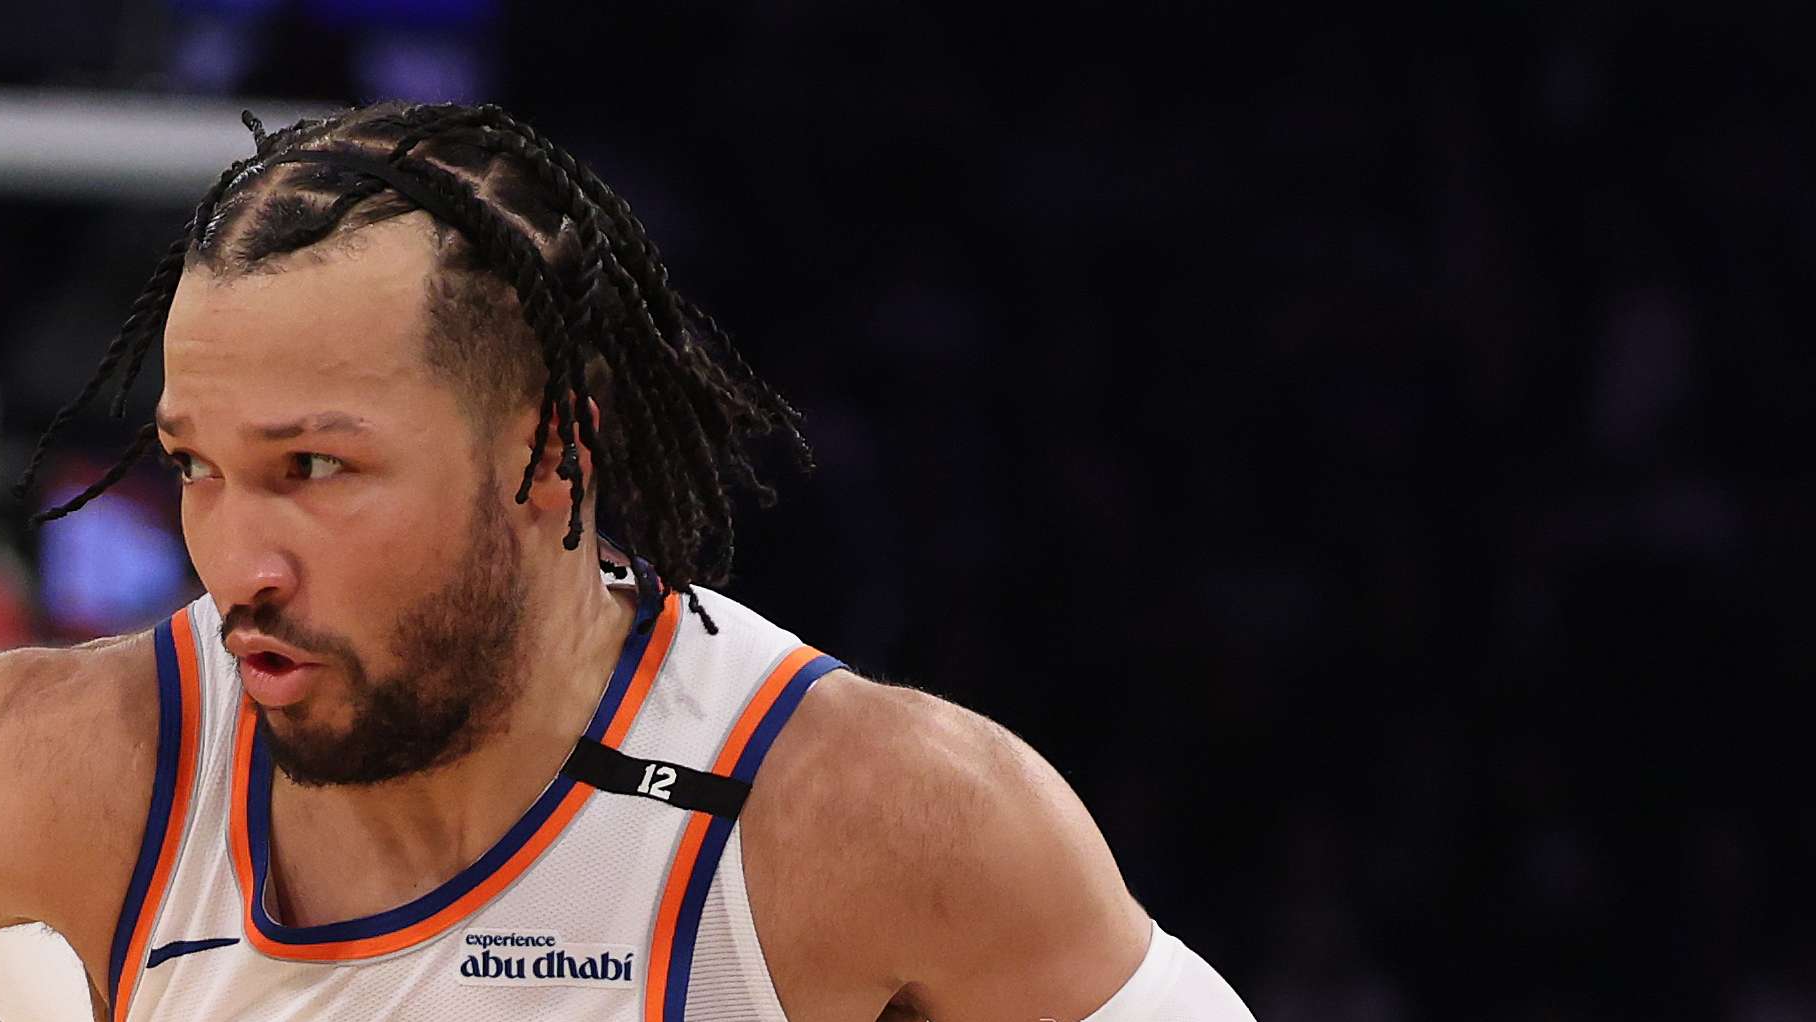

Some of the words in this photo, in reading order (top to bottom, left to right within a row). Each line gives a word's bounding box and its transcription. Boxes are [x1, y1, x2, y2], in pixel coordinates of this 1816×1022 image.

[637, 763, 677, 800] 12
[465, 932, 556, 948] experience
[460, 949, 526, 979] abu
